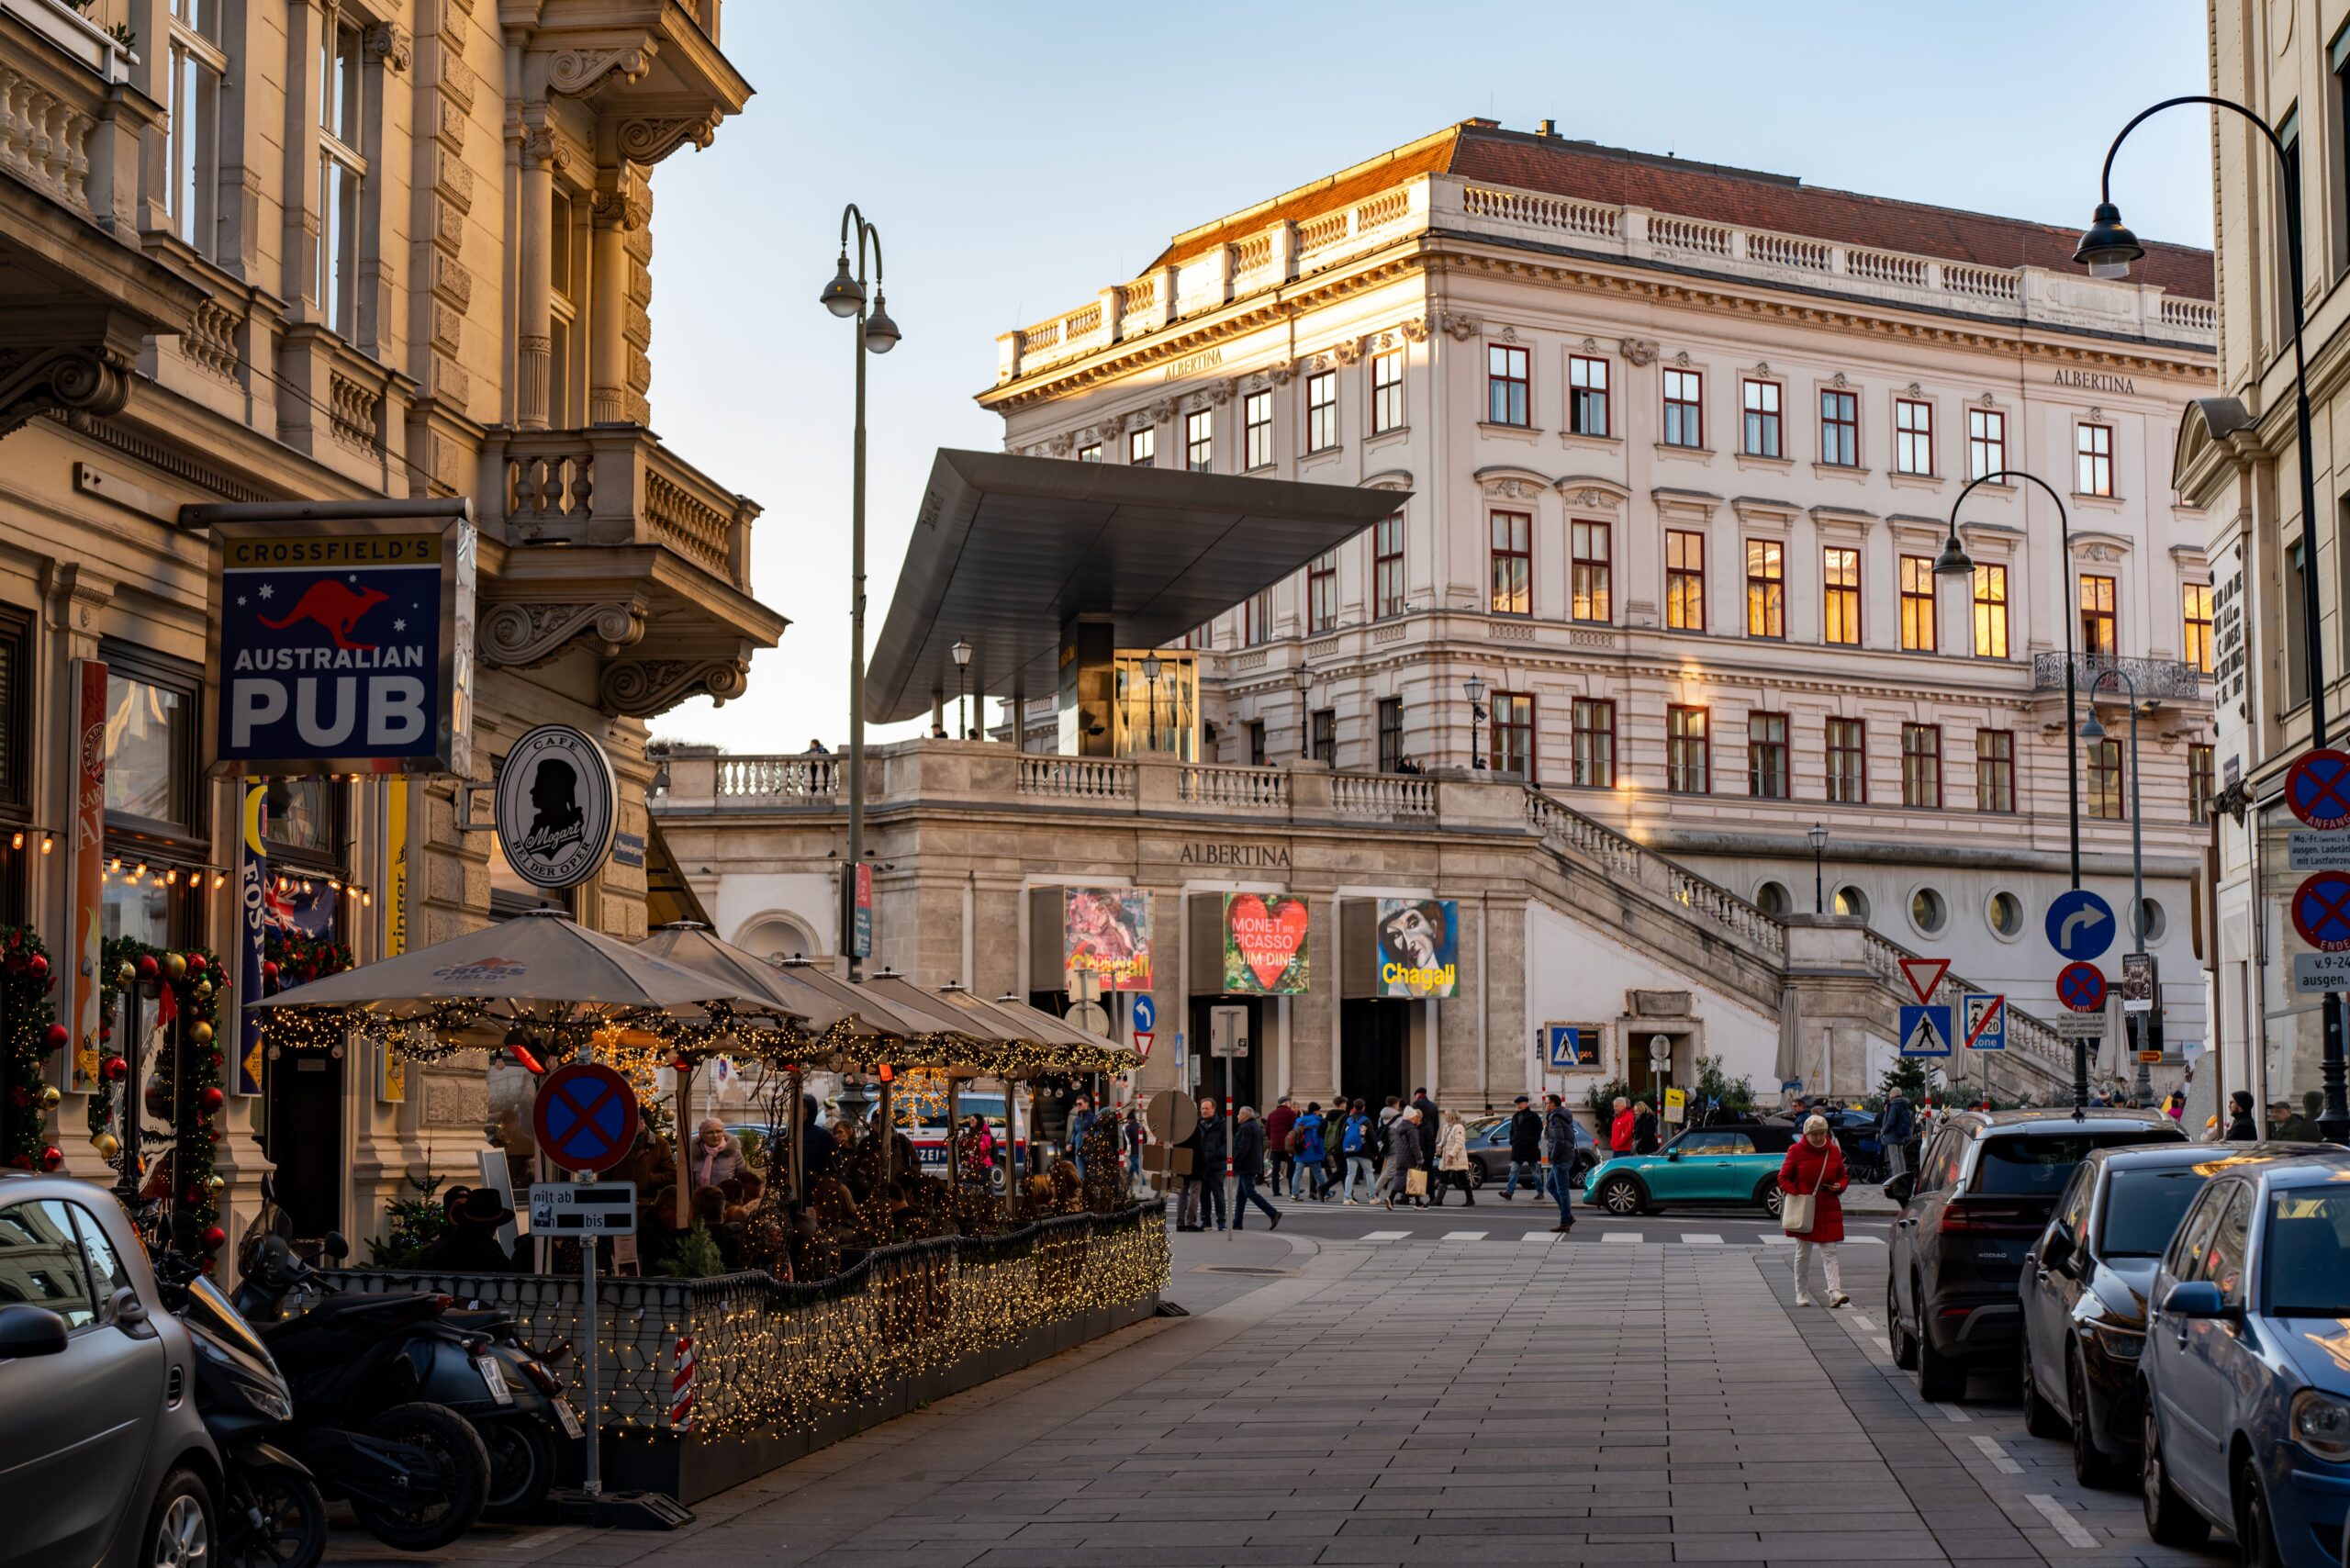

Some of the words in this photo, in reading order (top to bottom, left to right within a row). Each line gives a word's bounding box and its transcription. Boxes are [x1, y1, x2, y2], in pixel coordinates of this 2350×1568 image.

[1165, 348, 1222, 382] ALBERTINA
[2053, 368, 2134, 394] ALBERTINA
[236, 540, 430, 563] CROSSFIELD'S
[234, 645, 423, 671] AUSTRALIAN
[231, 676, 426, 747] PUB
[533, 736, 578, 752] CAFE
[2306, 813, 2350, 829] ANFANG
[525, 820, 582, 850] Mozart
[513, 840, 531, 866] BEI
[530, 863, 555, 876] DER
[560, 841, 590, 874] OPER
[1181, 843, 1291, 867] ALBERTINA
[1232, 917, 1282, 933] MONET
[1283, 925, 1294, 934] BIS
[1232, 934, 1293, 949] PICASSO
[2321, 939, 2350, 951] ENDE
[1088, 955, 1133, 969] ADRIAN
[1239, 952, 1262, 966] JIM
[1267, 952, 1297, 967] DINE
[432, 967, 527, 976] CROSS
[1382, 963, 1455, 991] Chagall
[2303, 976, 2348, 988] ausgen.
[1986, 1022, 1998, 1032] 20
[557, 1191, 572, 1204] ab
[586, 1214, 603, 1227] bis
